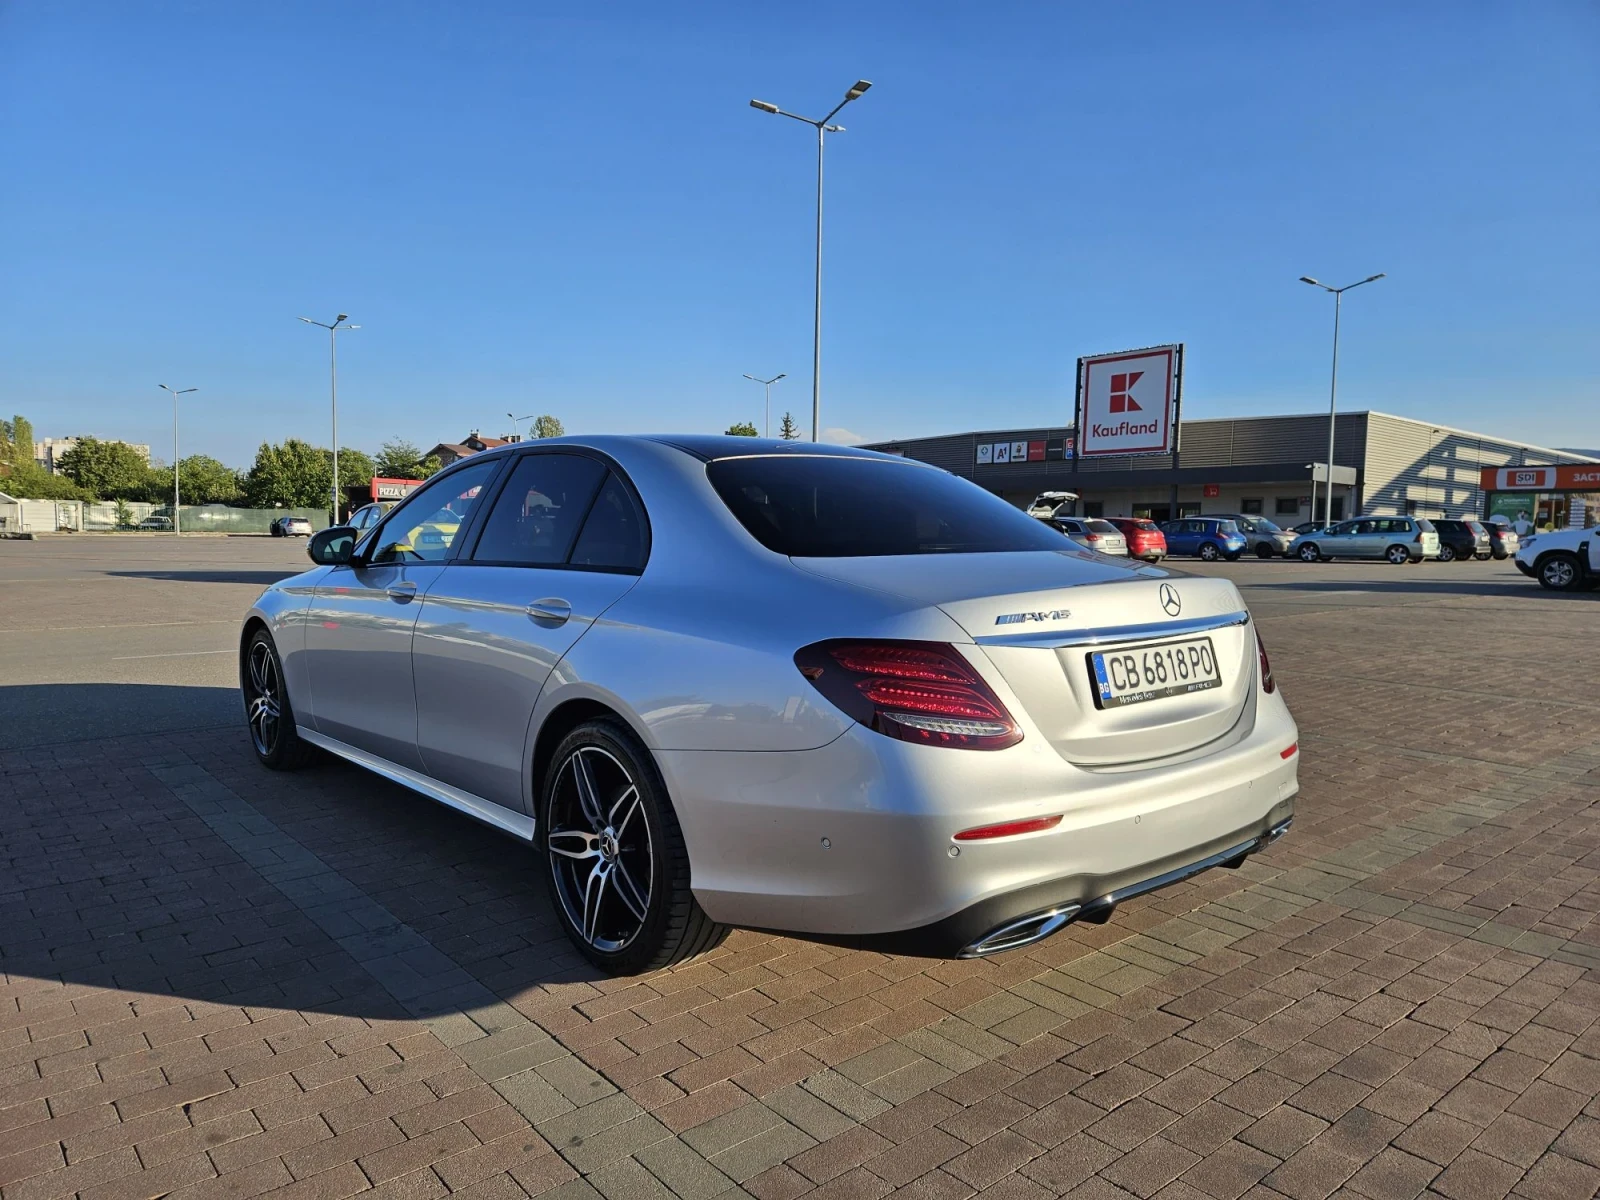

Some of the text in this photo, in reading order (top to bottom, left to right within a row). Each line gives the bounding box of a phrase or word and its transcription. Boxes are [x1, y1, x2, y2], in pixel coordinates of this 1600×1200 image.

[1092, 419, 1158, 438] Kaufland
[379, 487, 399, 496] PIZZA
[1100, 683, 1109, 694] BG
